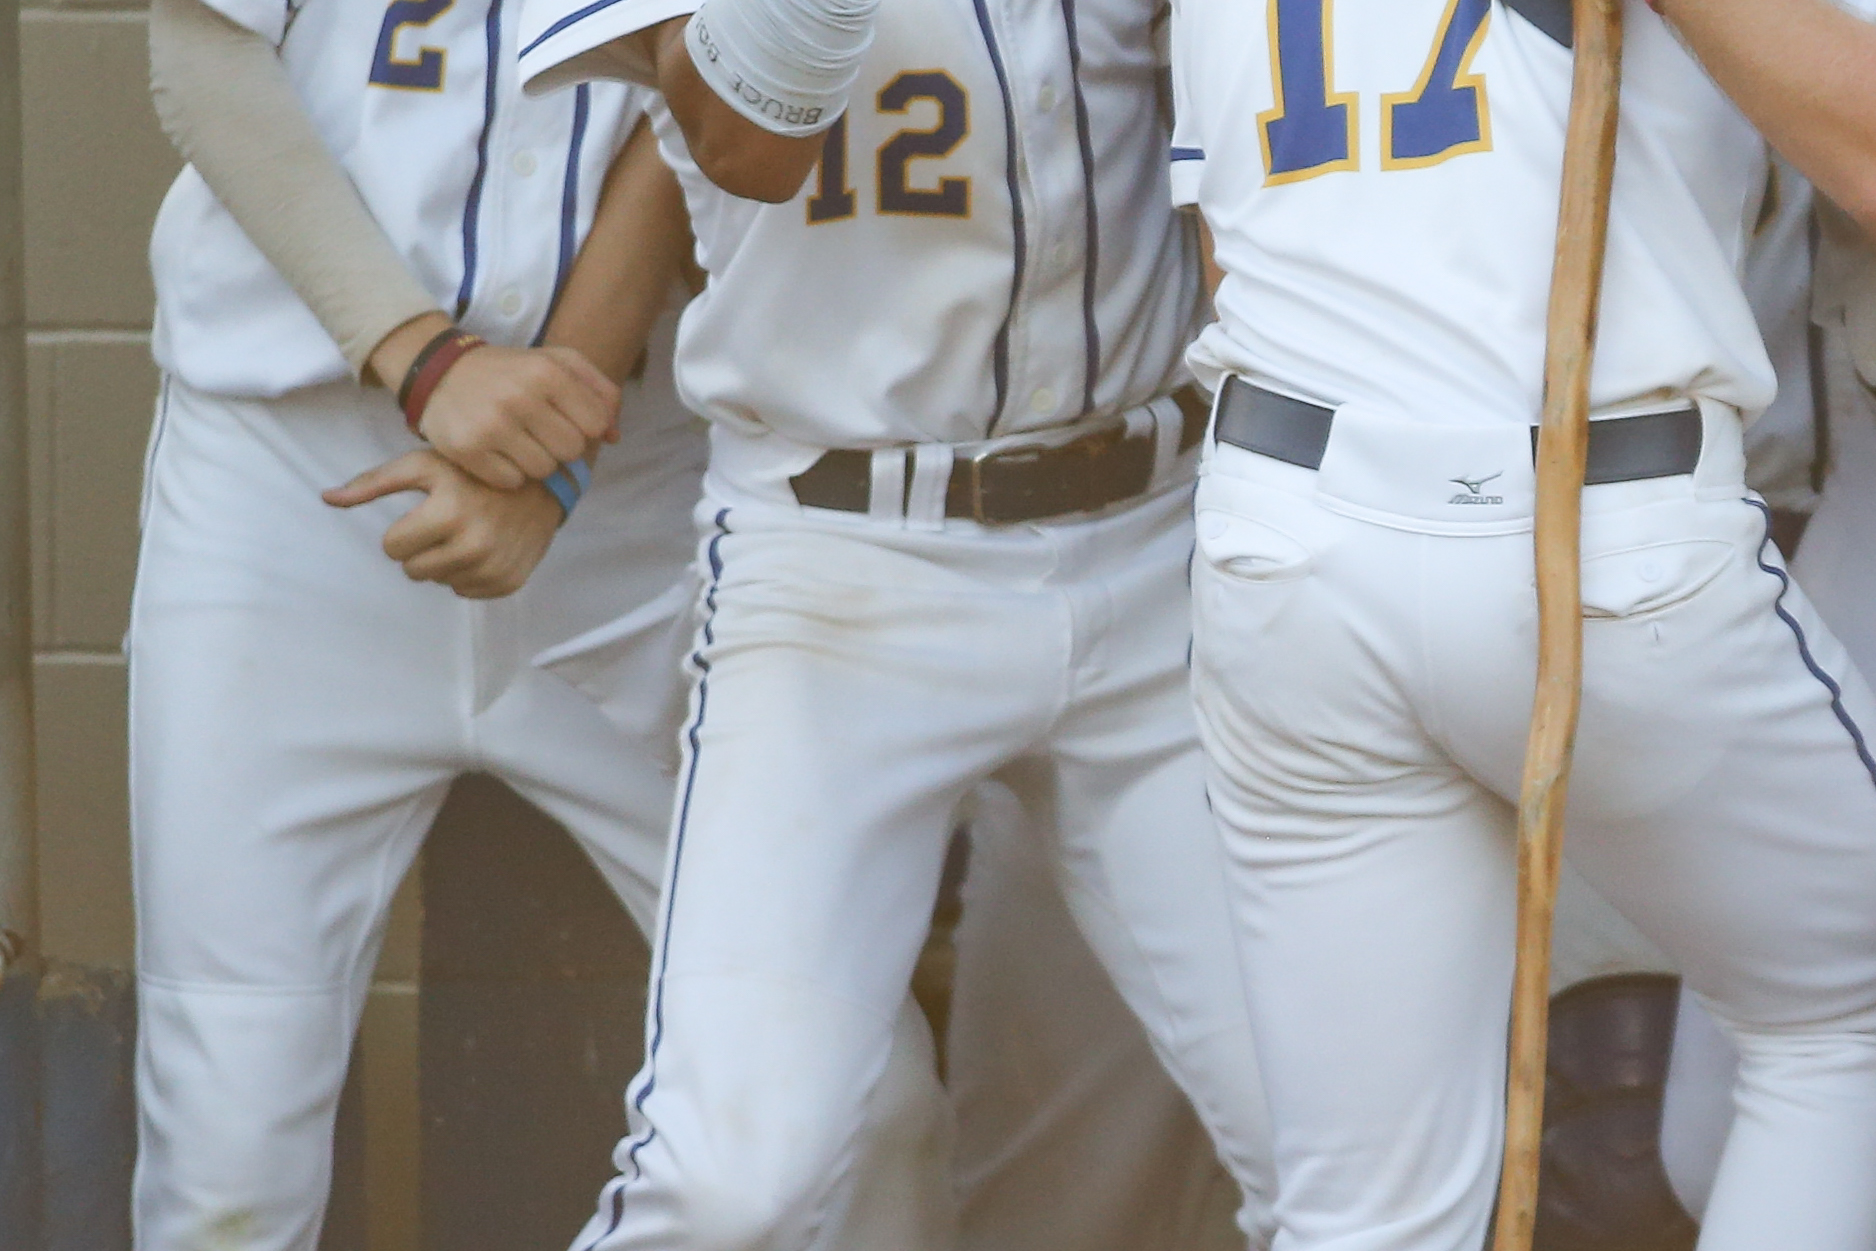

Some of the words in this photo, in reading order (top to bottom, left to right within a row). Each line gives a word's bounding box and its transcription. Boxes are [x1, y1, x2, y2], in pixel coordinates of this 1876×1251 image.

[728, 71, 824, 126] BRUCE
[805, 68, 973, 226] 12
[1446, 493, 1504, 506] MIZUNO
